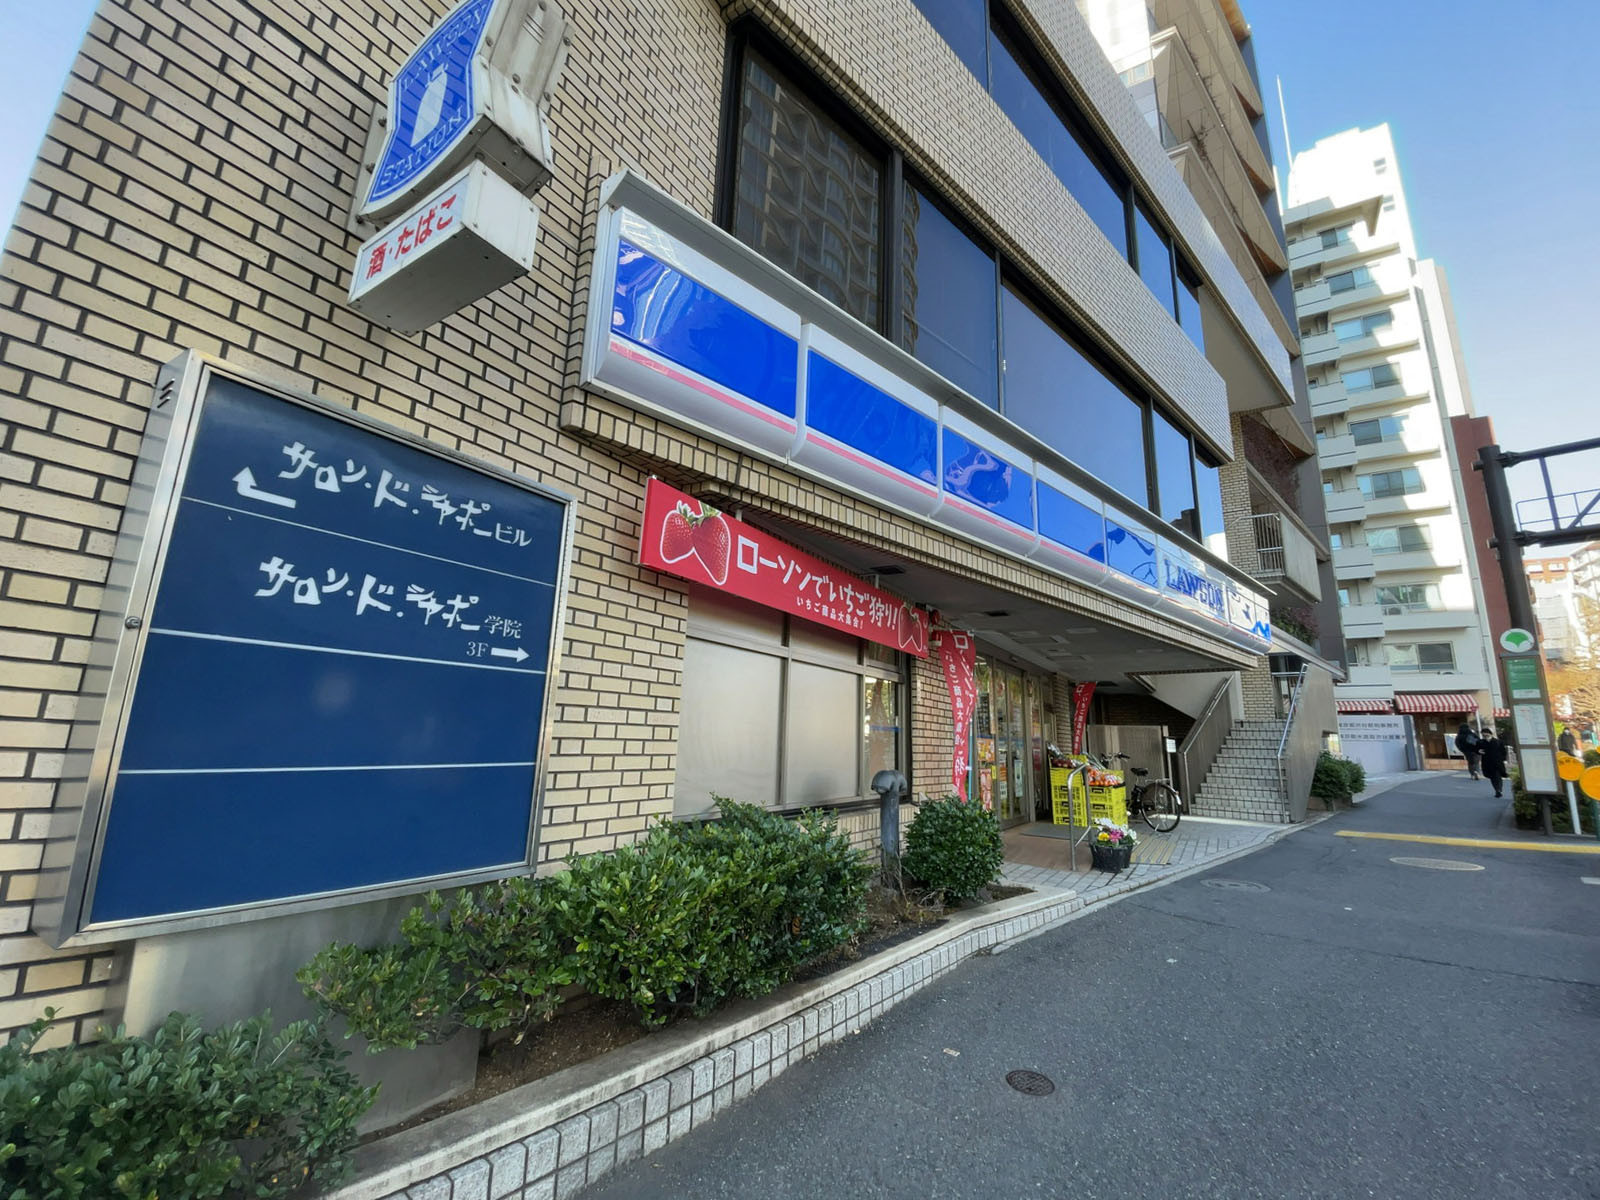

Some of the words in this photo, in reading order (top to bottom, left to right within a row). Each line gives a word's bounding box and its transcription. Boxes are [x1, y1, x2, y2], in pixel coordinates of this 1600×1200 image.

[380, 105, 465, 186] STATION
[366, 193, 458, 280] 酒・たばこ
[1164, 559, 1225, 613] LAWSON
[466, 642, 490, 658] 3F
